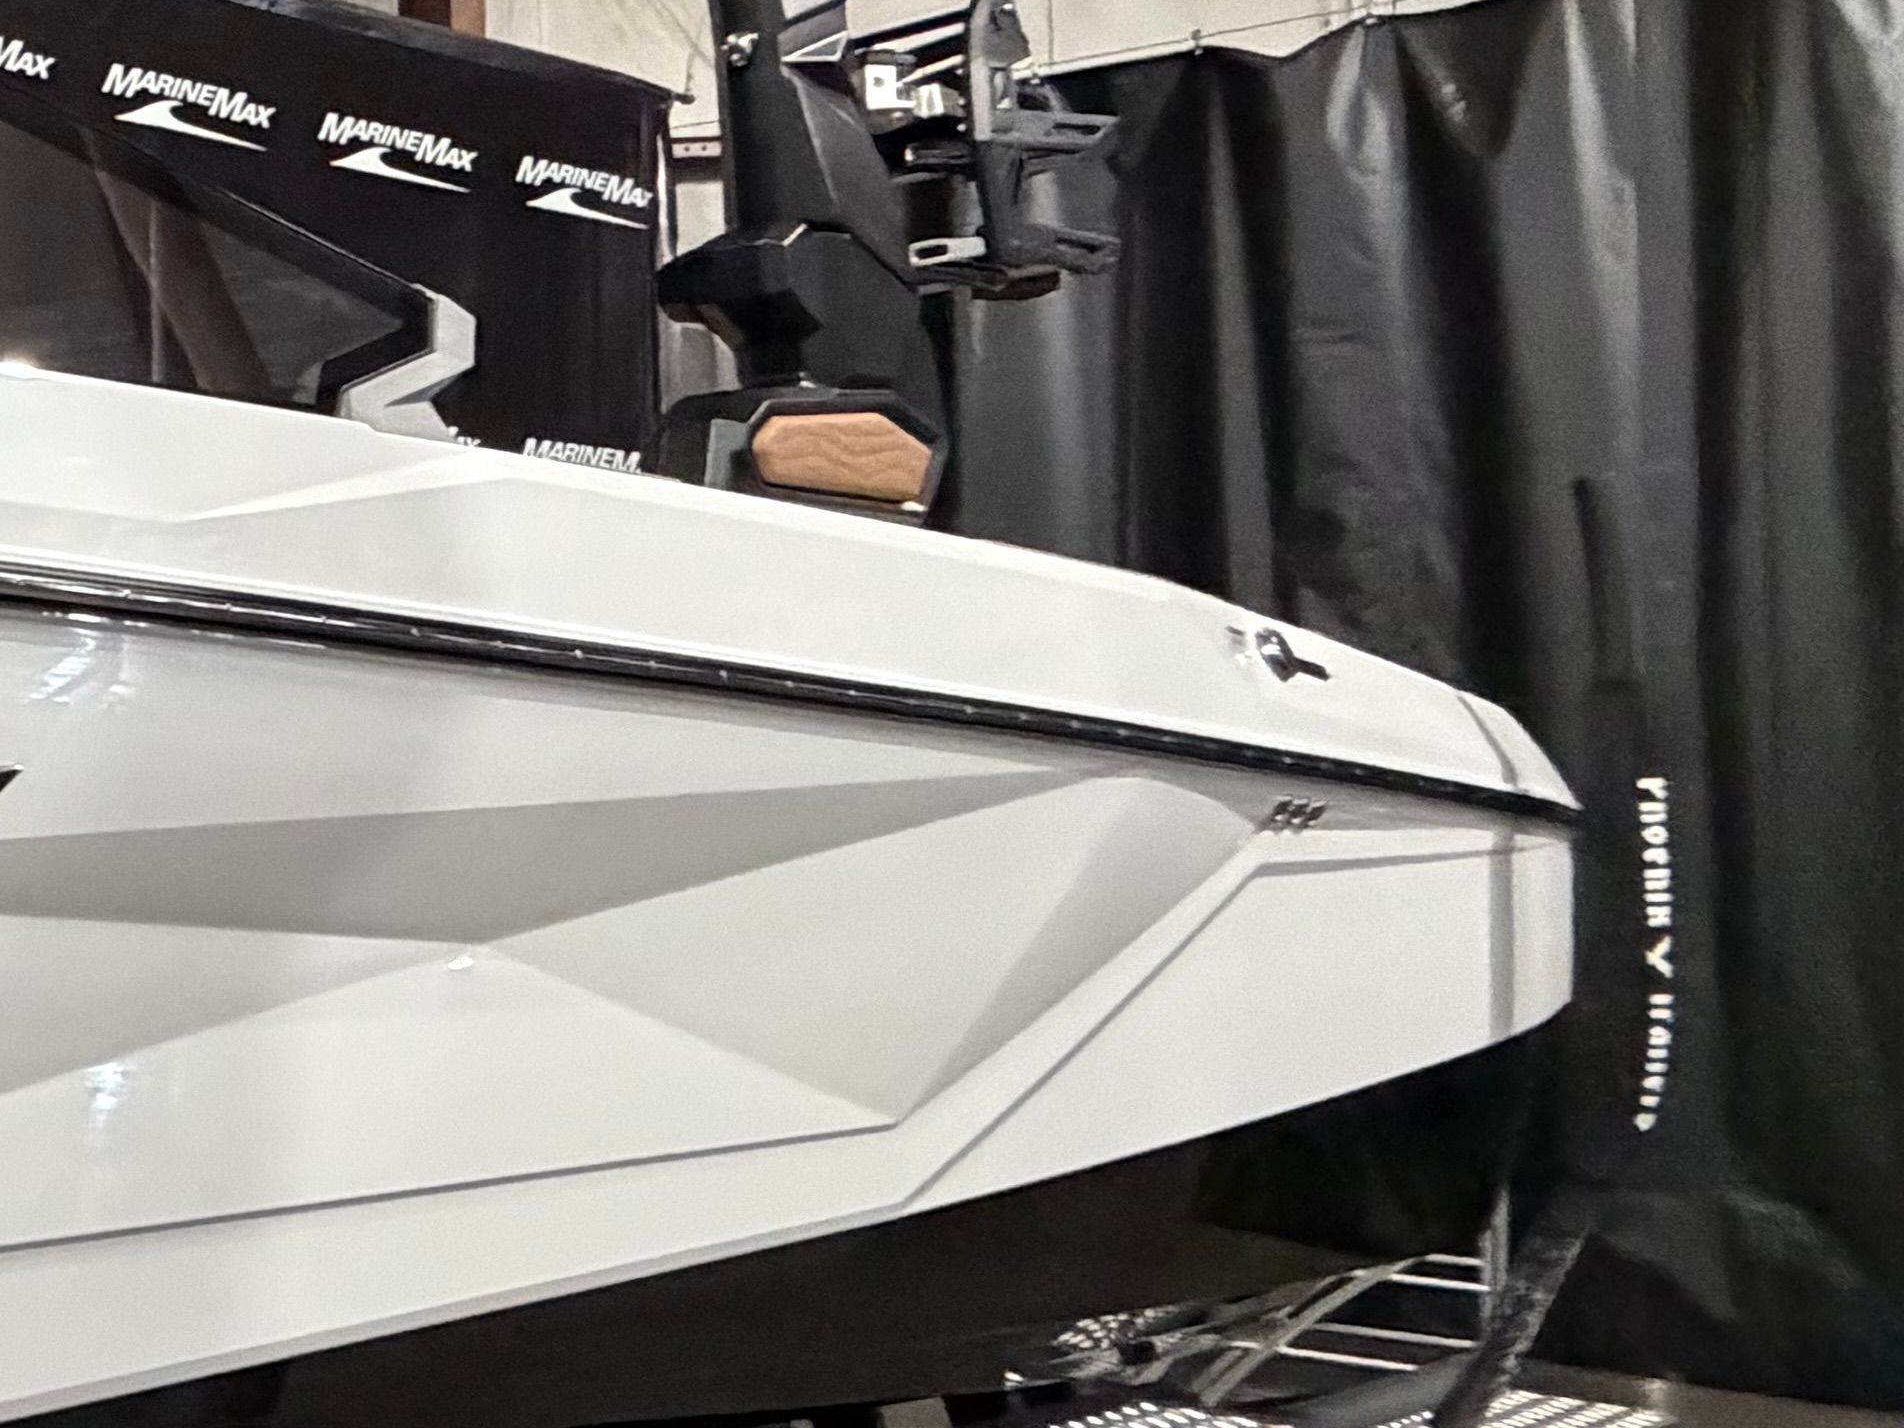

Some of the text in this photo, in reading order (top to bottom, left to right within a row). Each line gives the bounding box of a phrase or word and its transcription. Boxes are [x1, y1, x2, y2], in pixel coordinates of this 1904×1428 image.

[101, 63, 277, 130] MARINEMAX
[317, 112, 479, 173] MARINEMAX
[523, 437, 642, 474] MARINEM
